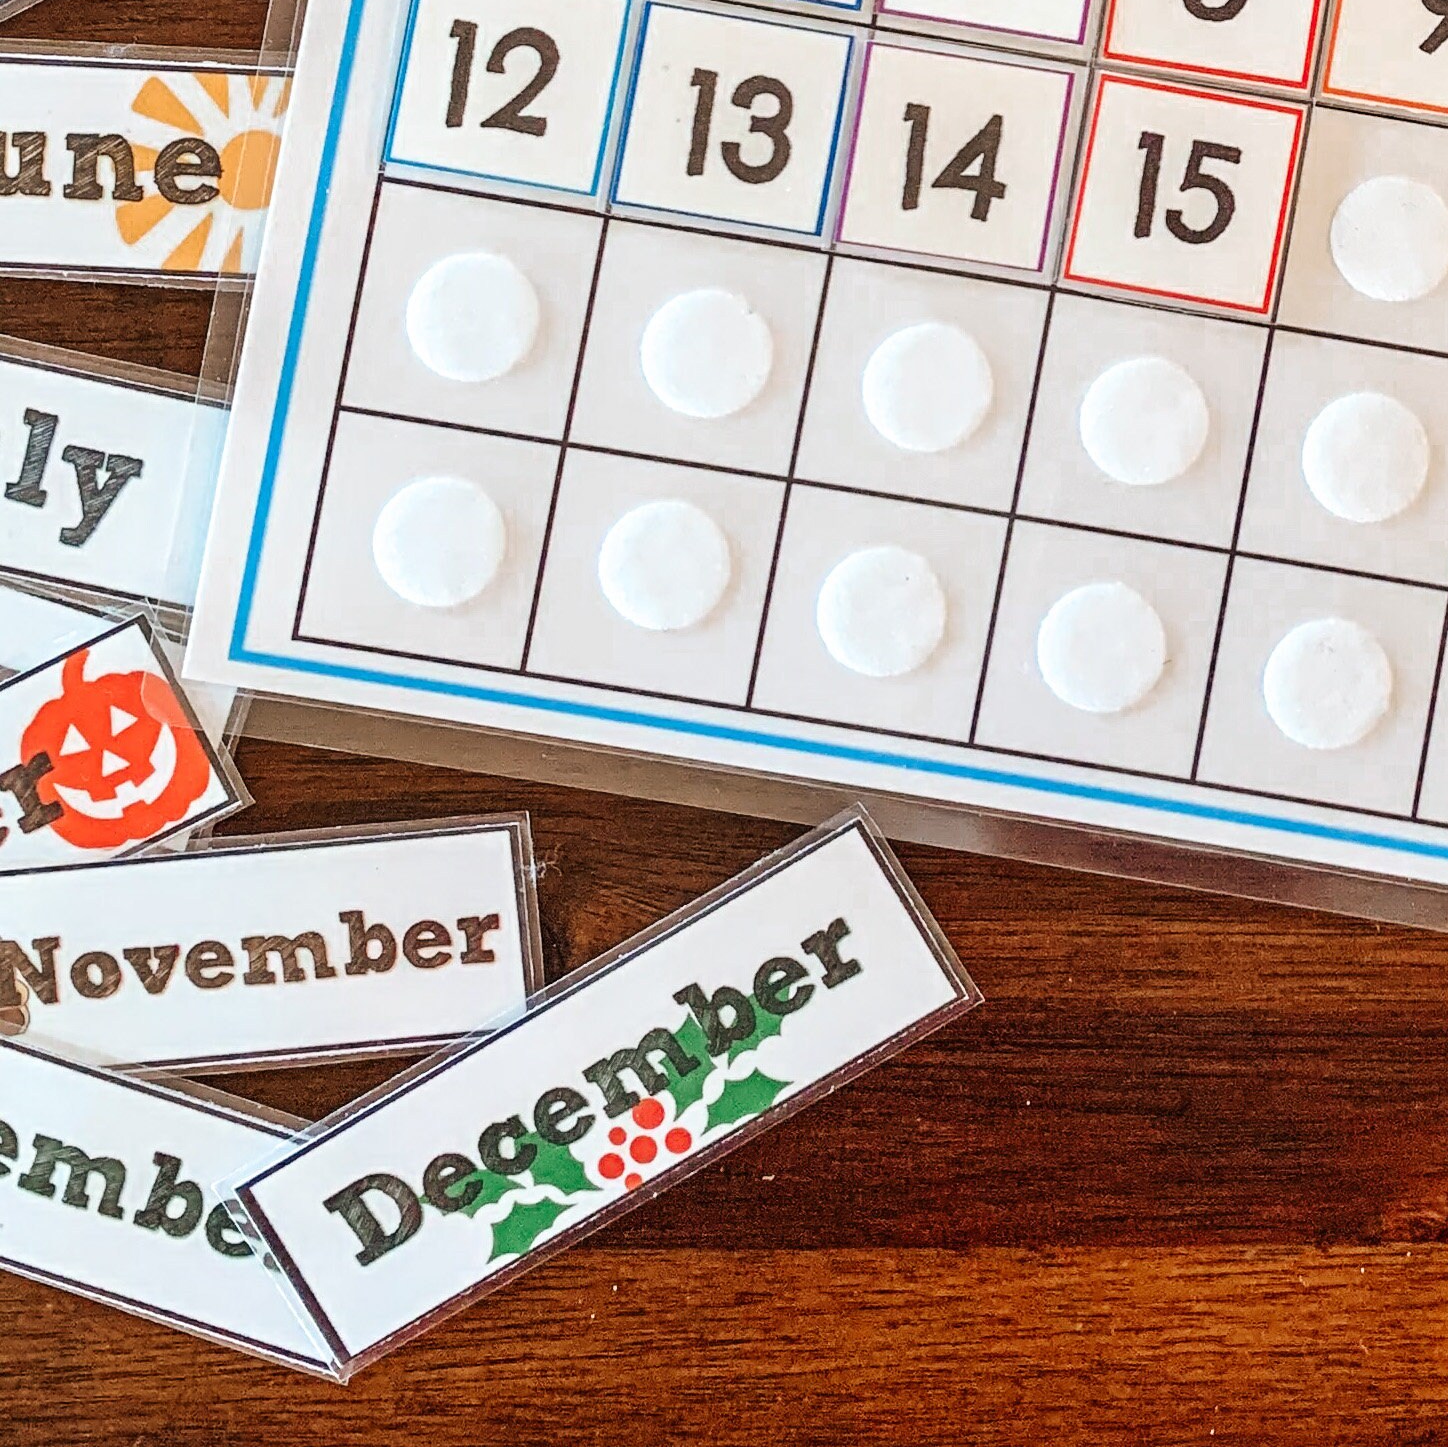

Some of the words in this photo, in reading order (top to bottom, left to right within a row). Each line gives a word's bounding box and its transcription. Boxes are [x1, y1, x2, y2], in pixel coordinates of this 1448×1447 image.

[445, 19, 560, 136] 12
[686, 67, 793, 184] 13
[901, 102, 1007, 222] 14
[1134, 131, 1242, 244] 15
[4, 407, 144, 548] ly
[0, 909, 500, 1005] November
[322, 917, 862, 1268] December
